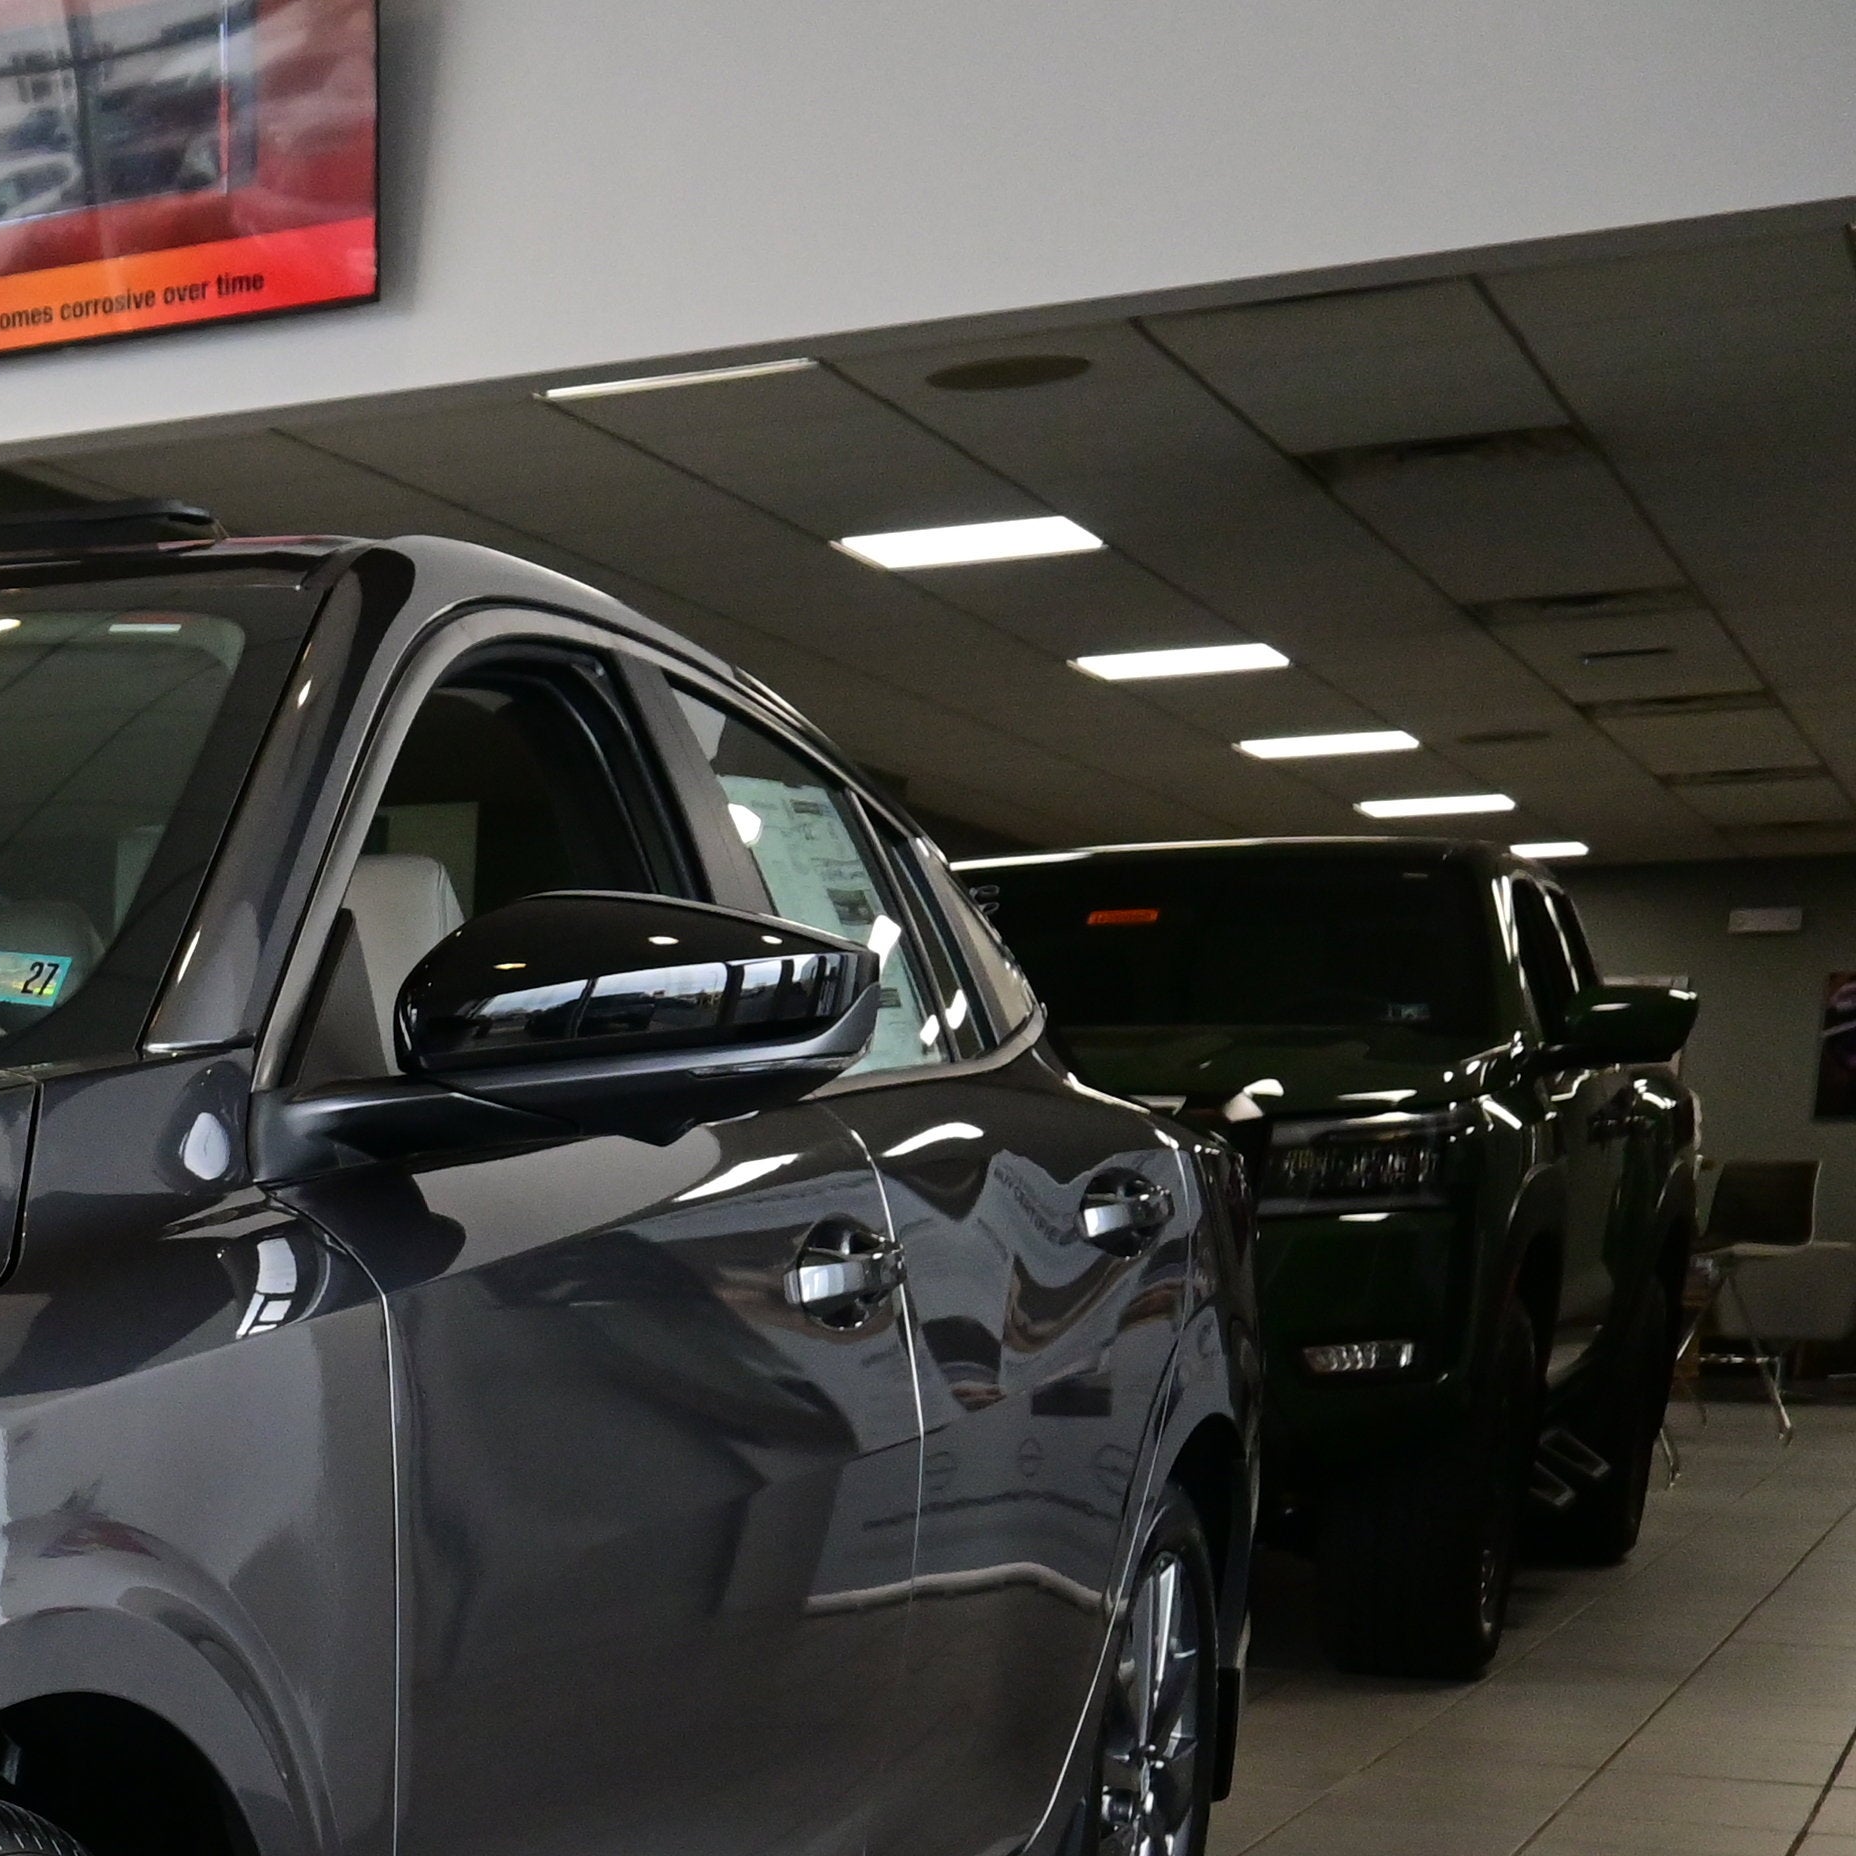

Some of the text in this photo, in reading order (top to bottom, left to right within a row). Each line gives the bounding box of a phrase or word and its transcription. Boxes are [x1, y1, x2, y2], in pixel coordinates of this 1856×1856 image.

[60, 288, 156, 321] corrosive
[162, 280, 211, 306] over
[215, 272, 265, 296] time
[20, 961, 60, 996] 27
